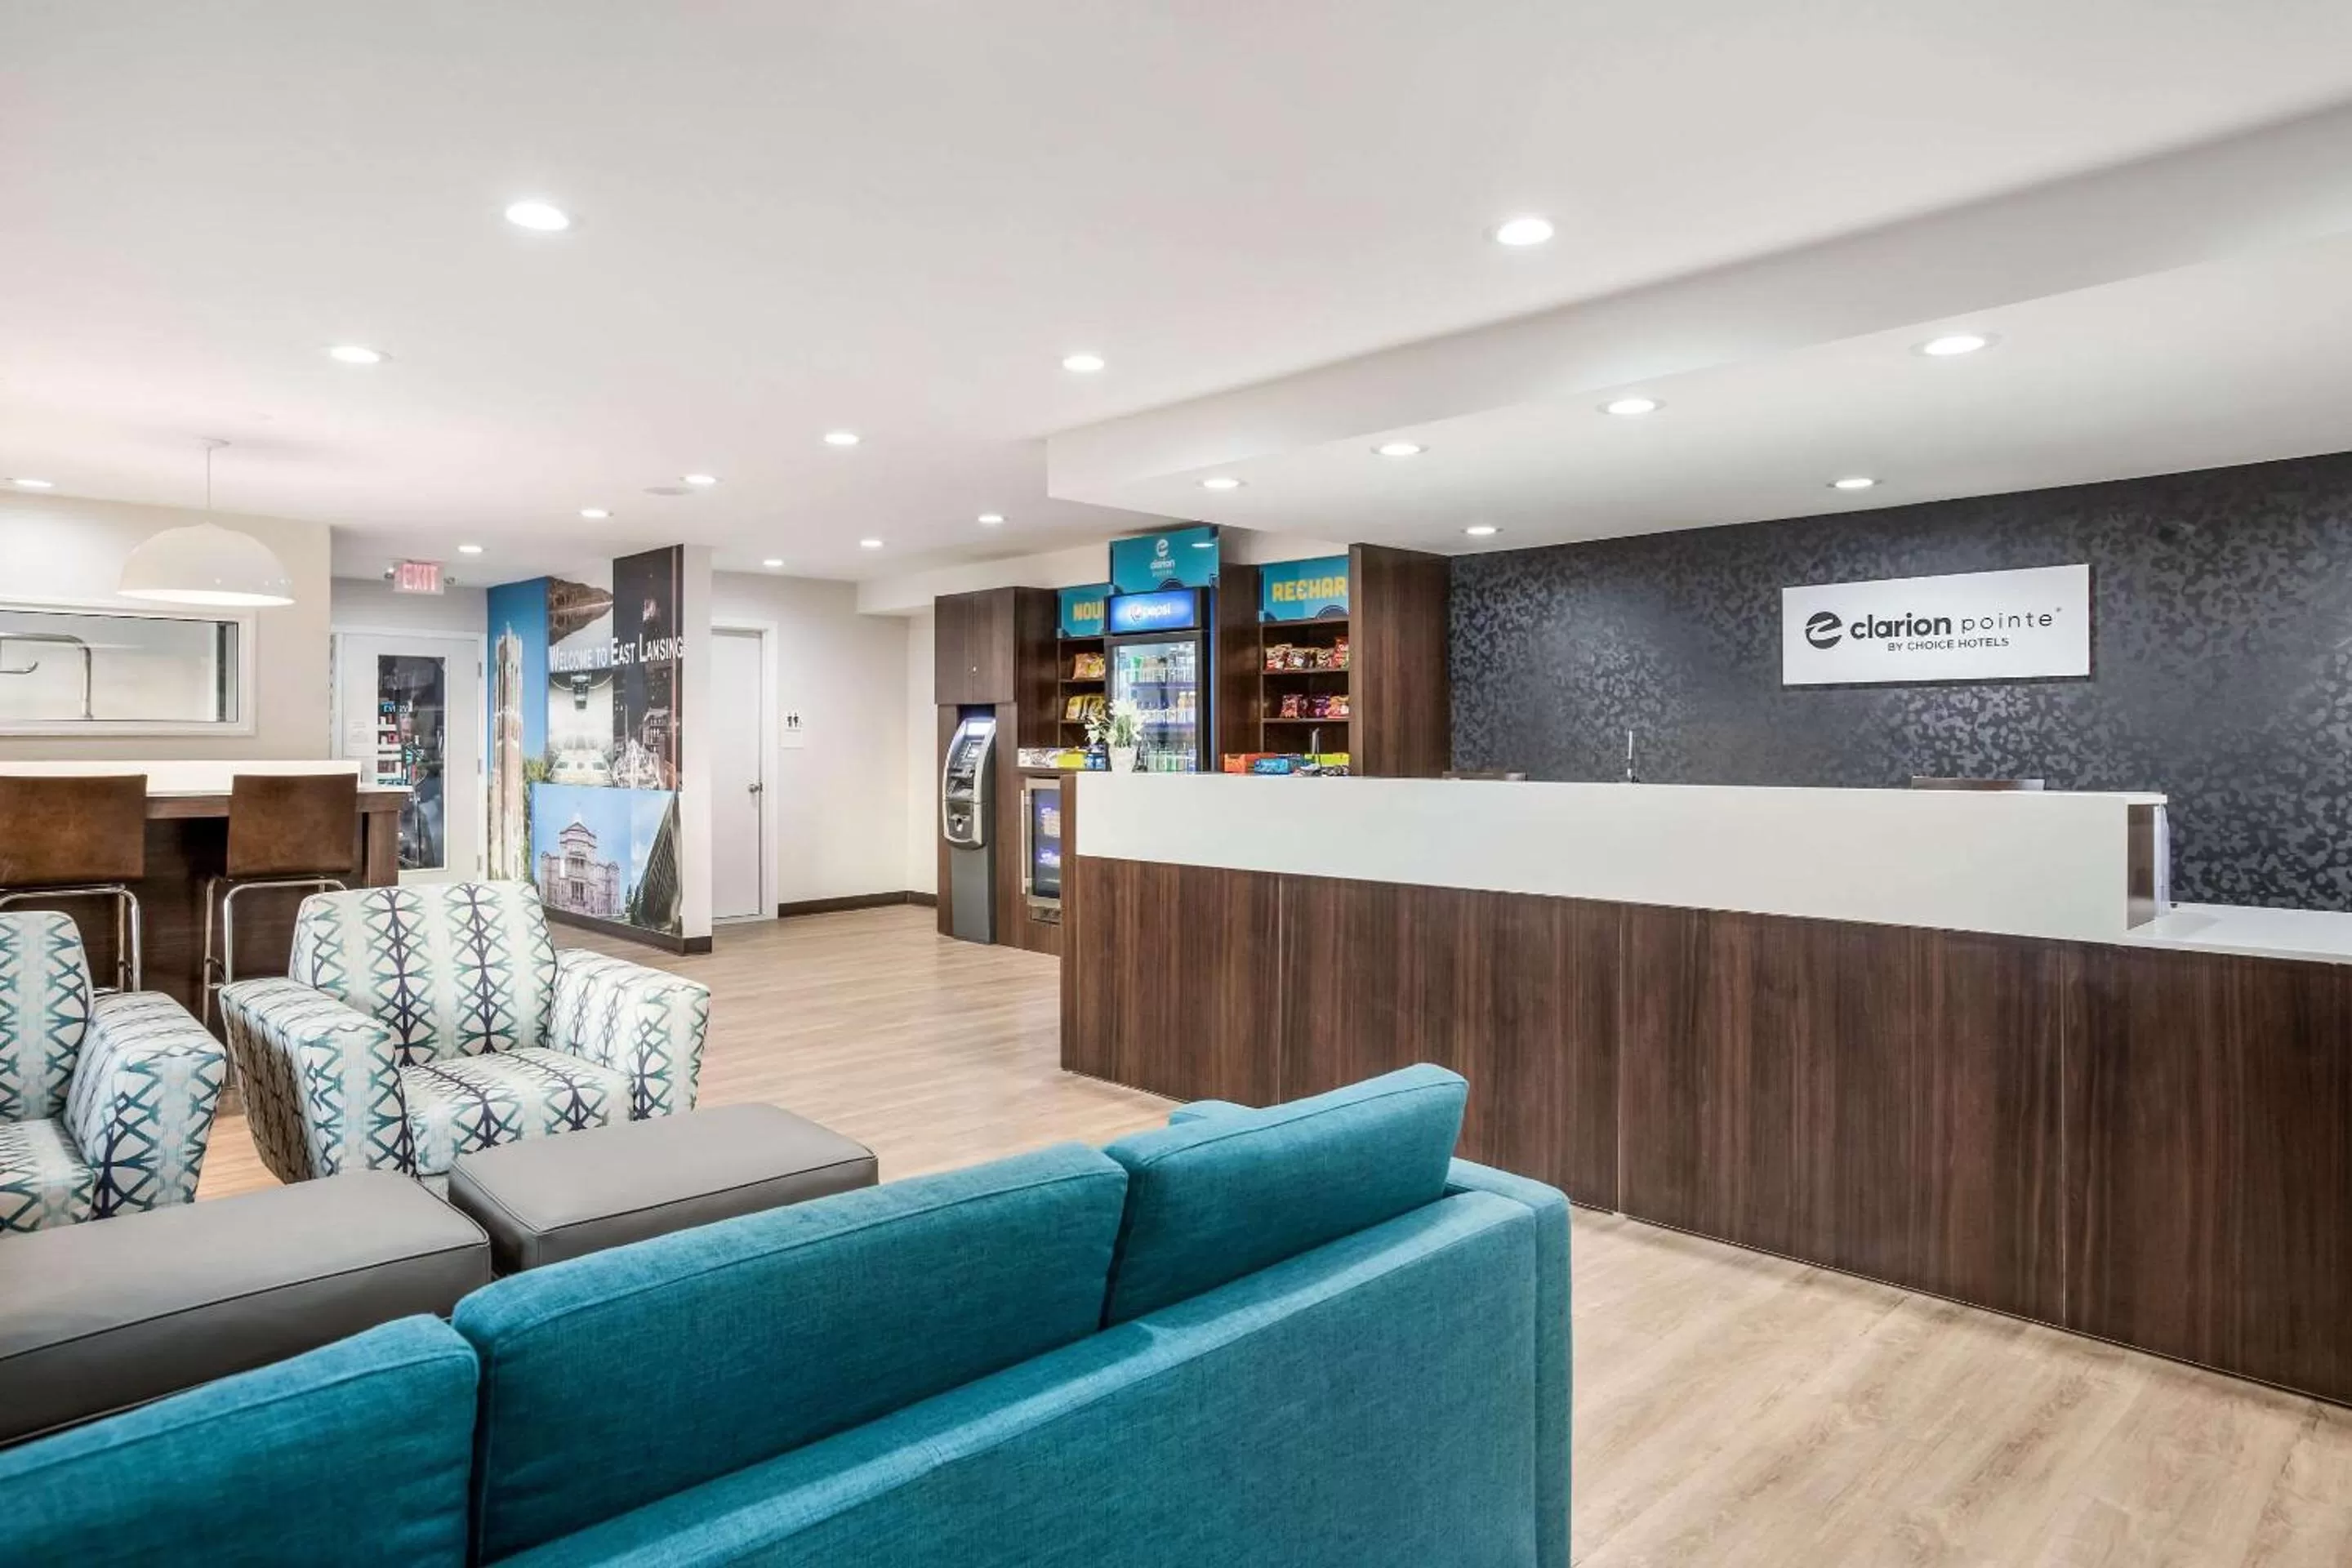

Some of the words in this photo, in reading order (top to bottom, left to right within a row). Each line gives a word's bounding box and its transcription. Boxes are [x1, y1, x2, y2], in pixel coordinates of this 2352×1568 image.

[403, 564, 439, 590] EXIT
[1850, 612, 1952, 639] clarion
[1962, 612, 2053, 635] pointe
[611, 637, 636, 666] EAST
[639, 634, 684, 663] LANSING
[1887, 641, 1903, 652] BY
[1908, 639, 1954, 651] CHOICE
[1958, 637, 2010, 648] HOTELS
